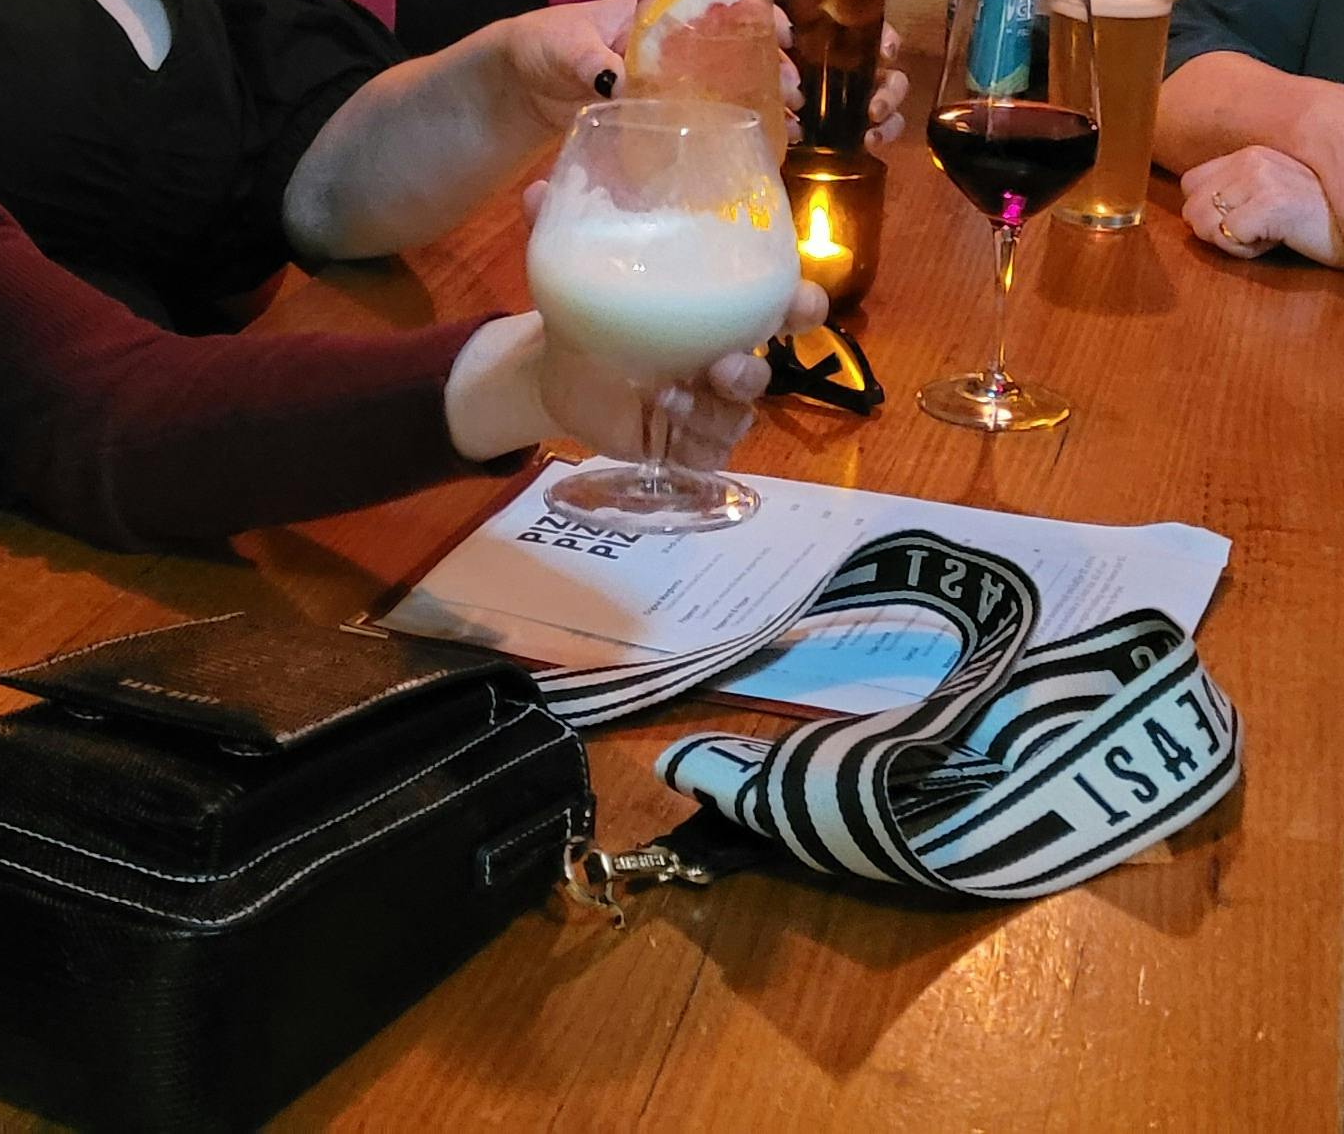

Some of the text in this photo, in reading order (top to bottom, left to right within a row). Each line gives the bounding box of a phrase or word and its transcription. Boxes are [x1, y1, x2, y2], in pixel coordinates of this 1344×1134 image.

[516, 512, 571, 544] PIZ
[552, 523, 604, 552] PIZ
[586, 531, 643, 560] PIZ
